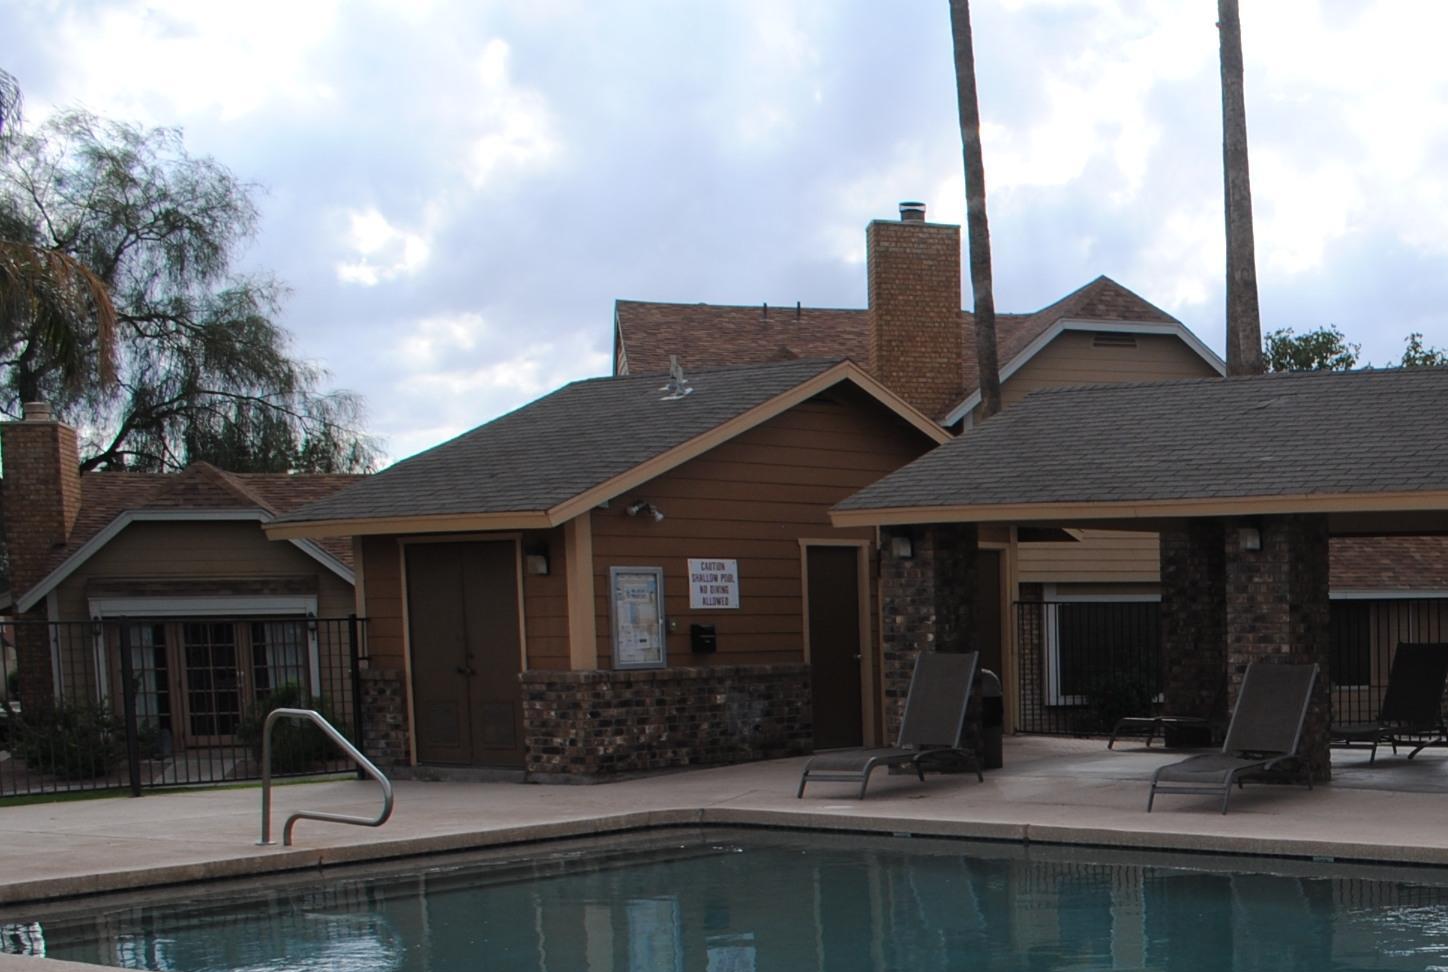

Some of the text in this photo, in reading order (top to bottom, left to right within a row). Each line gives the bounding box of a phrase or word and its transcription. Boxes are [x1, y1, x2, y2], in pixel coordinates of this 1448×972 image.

[701, 562, 725, 571] CAUTION
[692, 574, 735, 583] SHALLOW POOL
[699, 585, 729, 594] NO DIVING
[702, 597, 728, 606] ALLOWED
